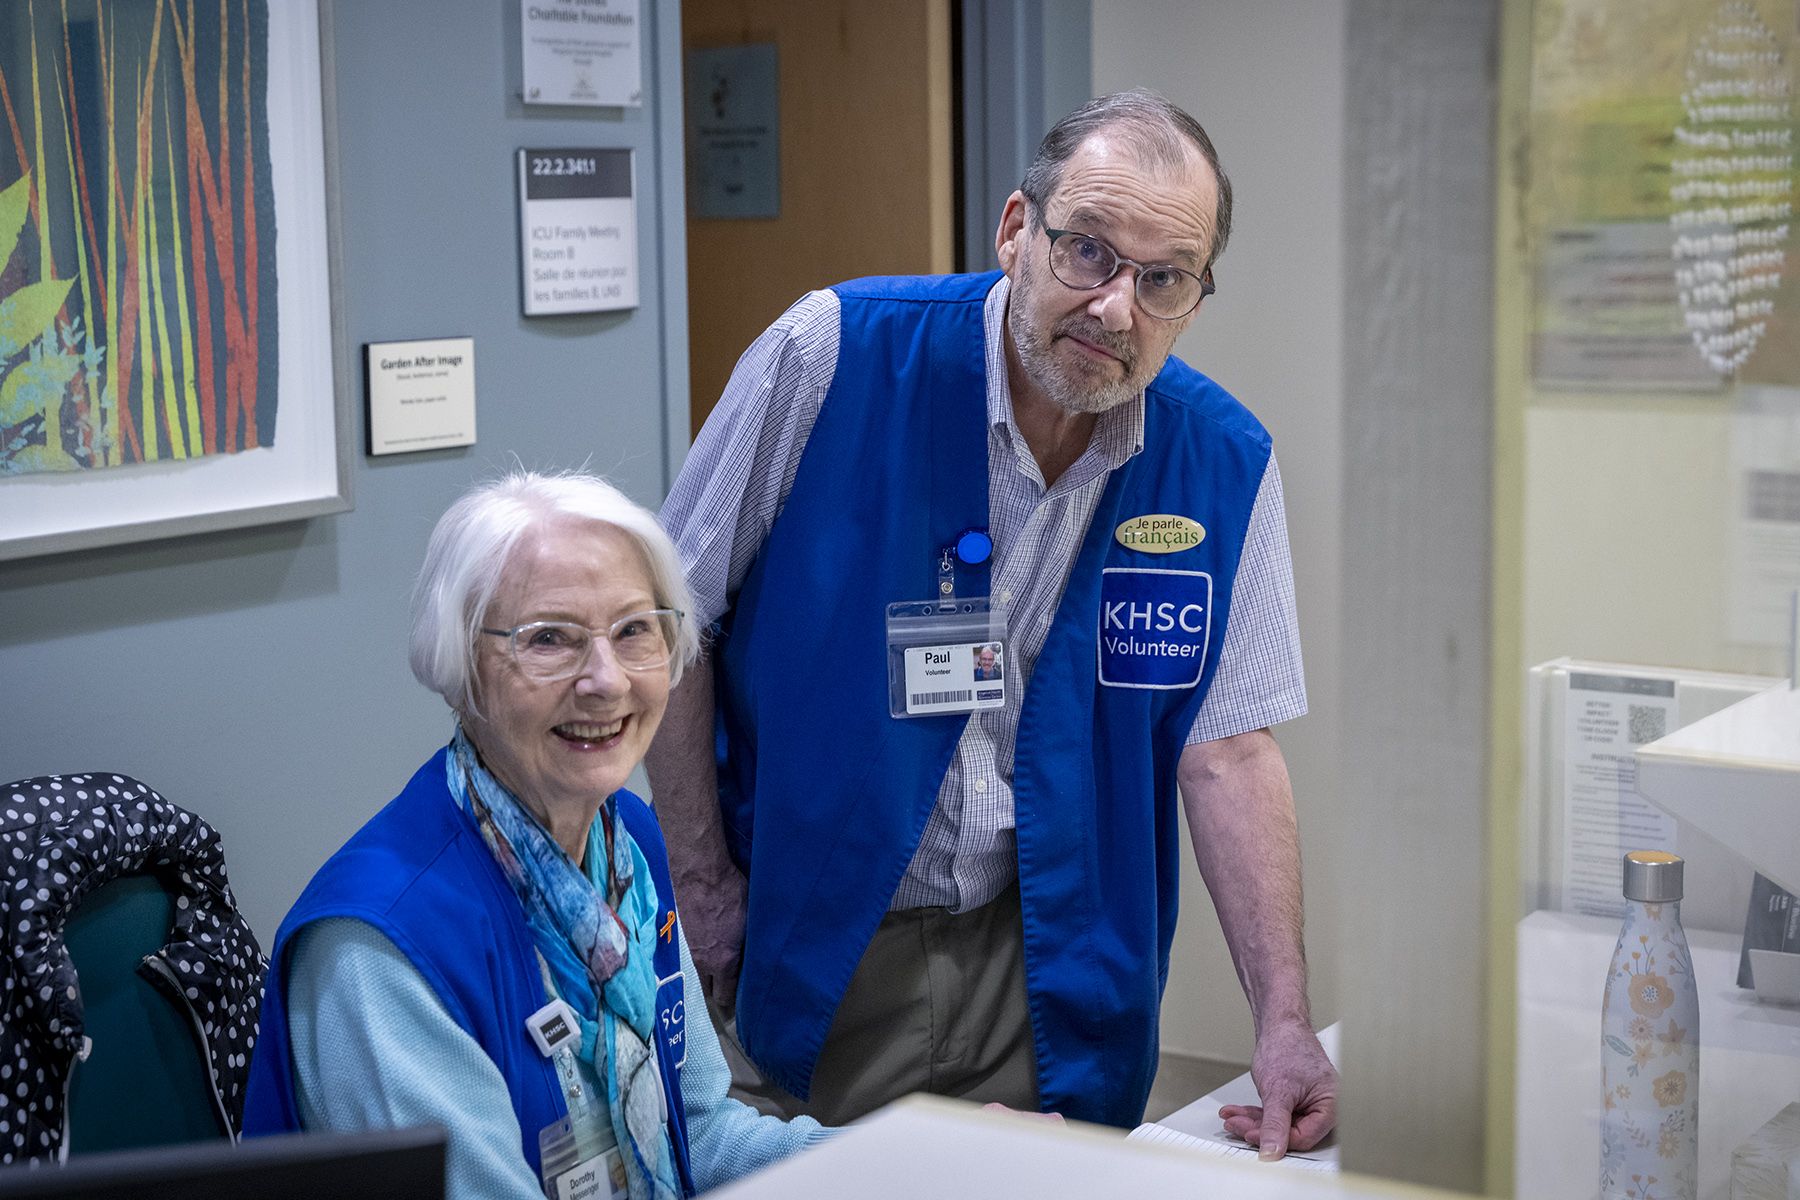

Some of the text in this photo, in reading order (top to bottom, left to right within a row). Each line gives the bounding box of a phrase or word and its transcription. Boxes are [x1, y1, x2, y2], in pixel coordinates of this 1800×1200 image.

[581, 10, 634, 26] Foundation
[531, 225, 553, 240] ICU
[555, 225, 587, 242] Family
[532, 247, 566, 261] Room
[533, 268, 560, 282] Salle
[562, 268, 576, 281] de
[533, 290, 551, 302] les
[552, 286, 589, 301] familles
[381, 354, 463, 371] Garden After Image
[1136, 518, 1183, 531] Je parle
[1123, 526, 1199, 549] français
[1104, 601, 1204, 634] KHSC
[1104, 635, 1200, 658] Volunteer
[924, 651, 951, 665] Paul
[925, 668, 952, 677] Volunteer
[662, 1000, 683, 1031] SC
[545, 1021, 566, 1040] KHSC
[570, 1169, 595, 1190] Dorothy
